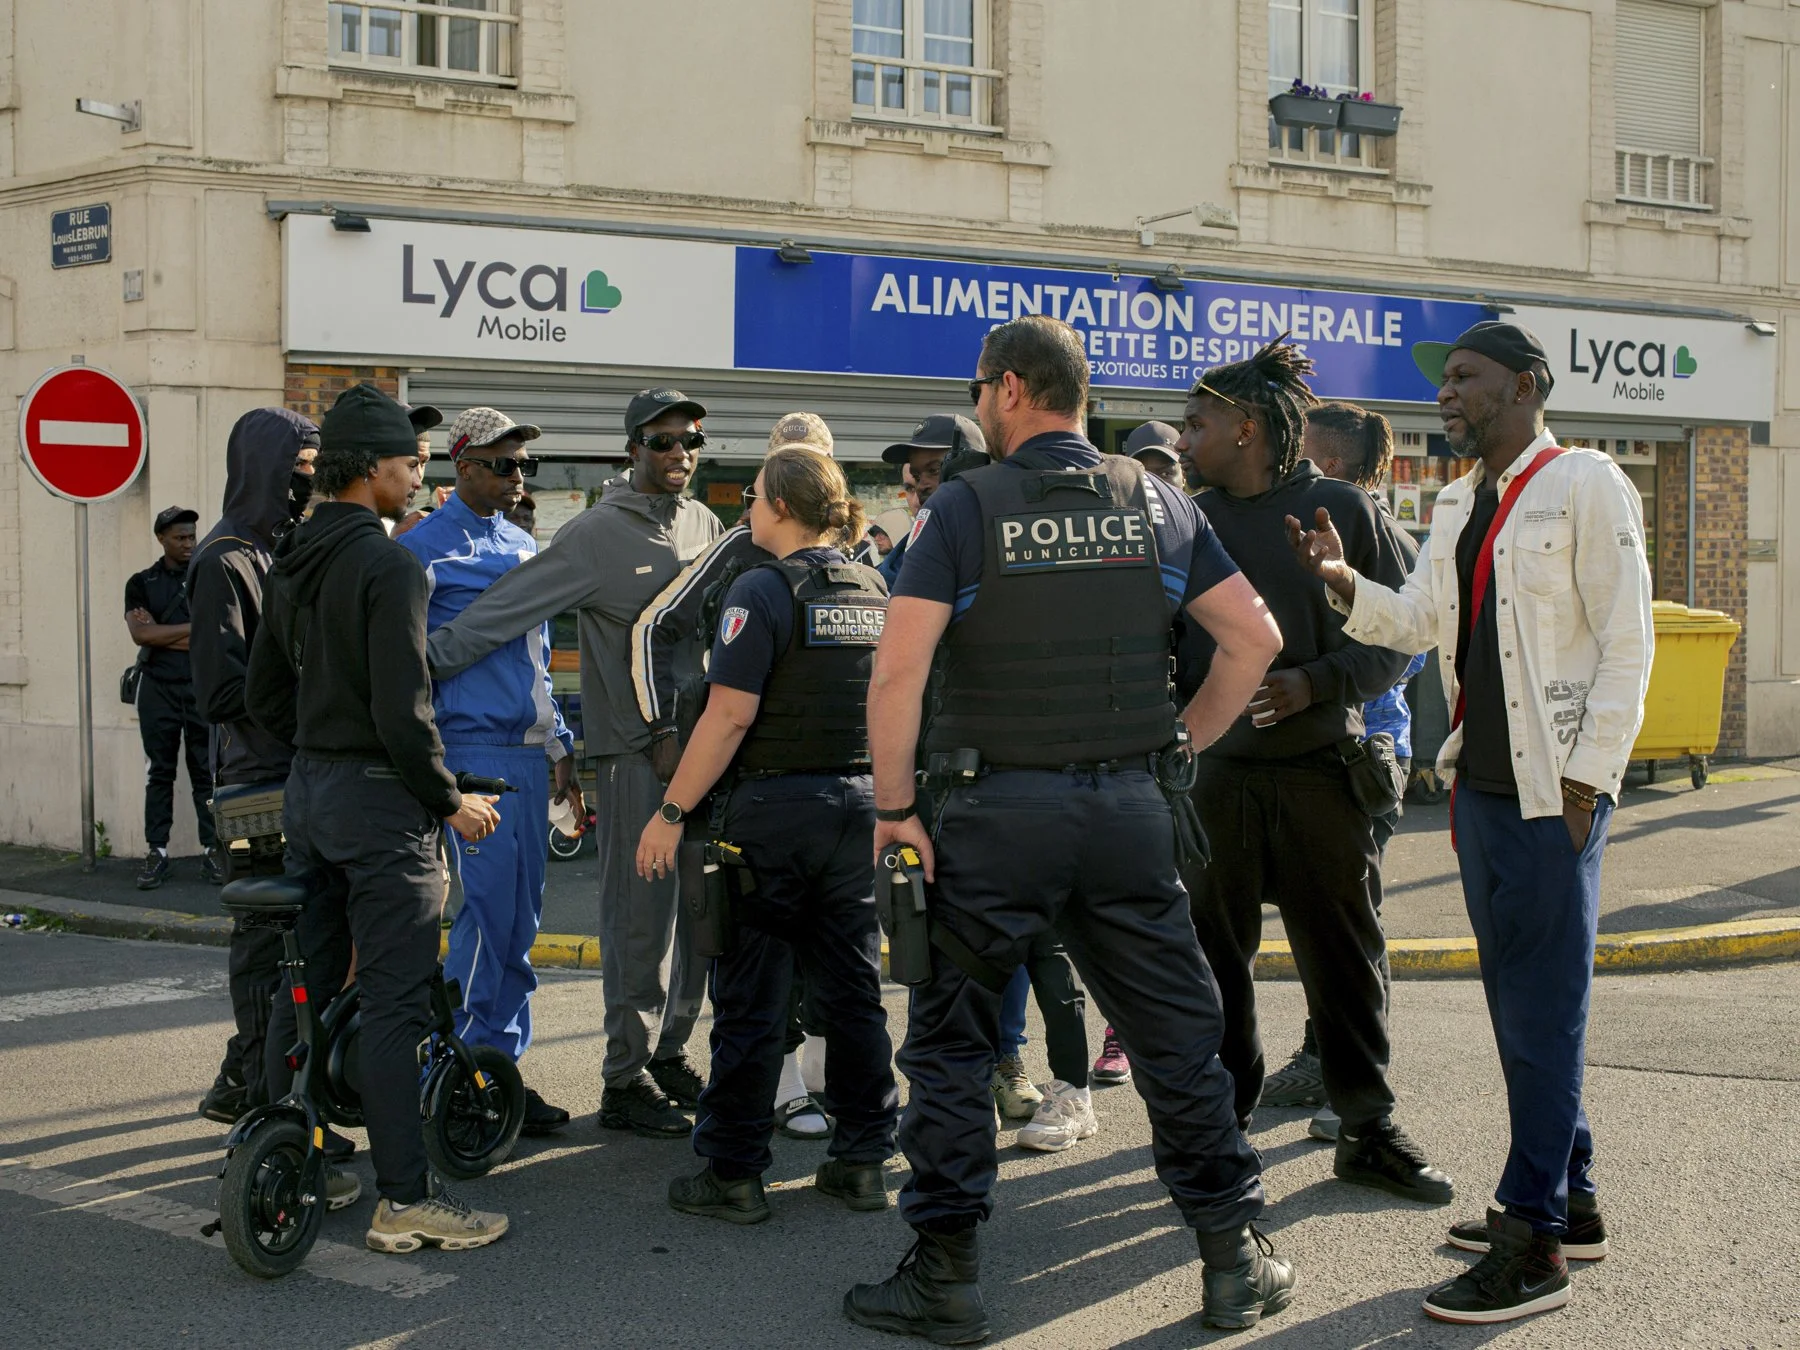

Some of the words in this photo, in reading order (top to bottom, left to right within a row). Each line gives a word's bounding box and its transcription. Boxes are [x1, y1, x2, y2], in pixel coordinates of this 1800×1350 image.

[69, 210, 90, 226] RUE
[72, 224, 108, 242] LEBRUN
[403, 244, 567, 318] Lyca
[871, 273, 1193, 332] ALIMENTATION
[1207, 298, 1402, 347] GENERALE
[477, 315, 567, 342] Mobile
[1570, 328, 1665, 383] Lyca
[1089, 361, 1167, 379] EXOTIQUES
[1172, 366, 1188, 379] ET
[654, 391, 678, 399] GUCCI
[1613, 381, 1665, 401] Mobile
[783, 425, 807, 433] GUCCI
[1002, 515, 1143, 548] POLICE
[1005, 545, 1146, 562] MUNICIPALE
[815, 609, 884, 625] POLICE
[789, 1097, 810, 1109] NIKE
